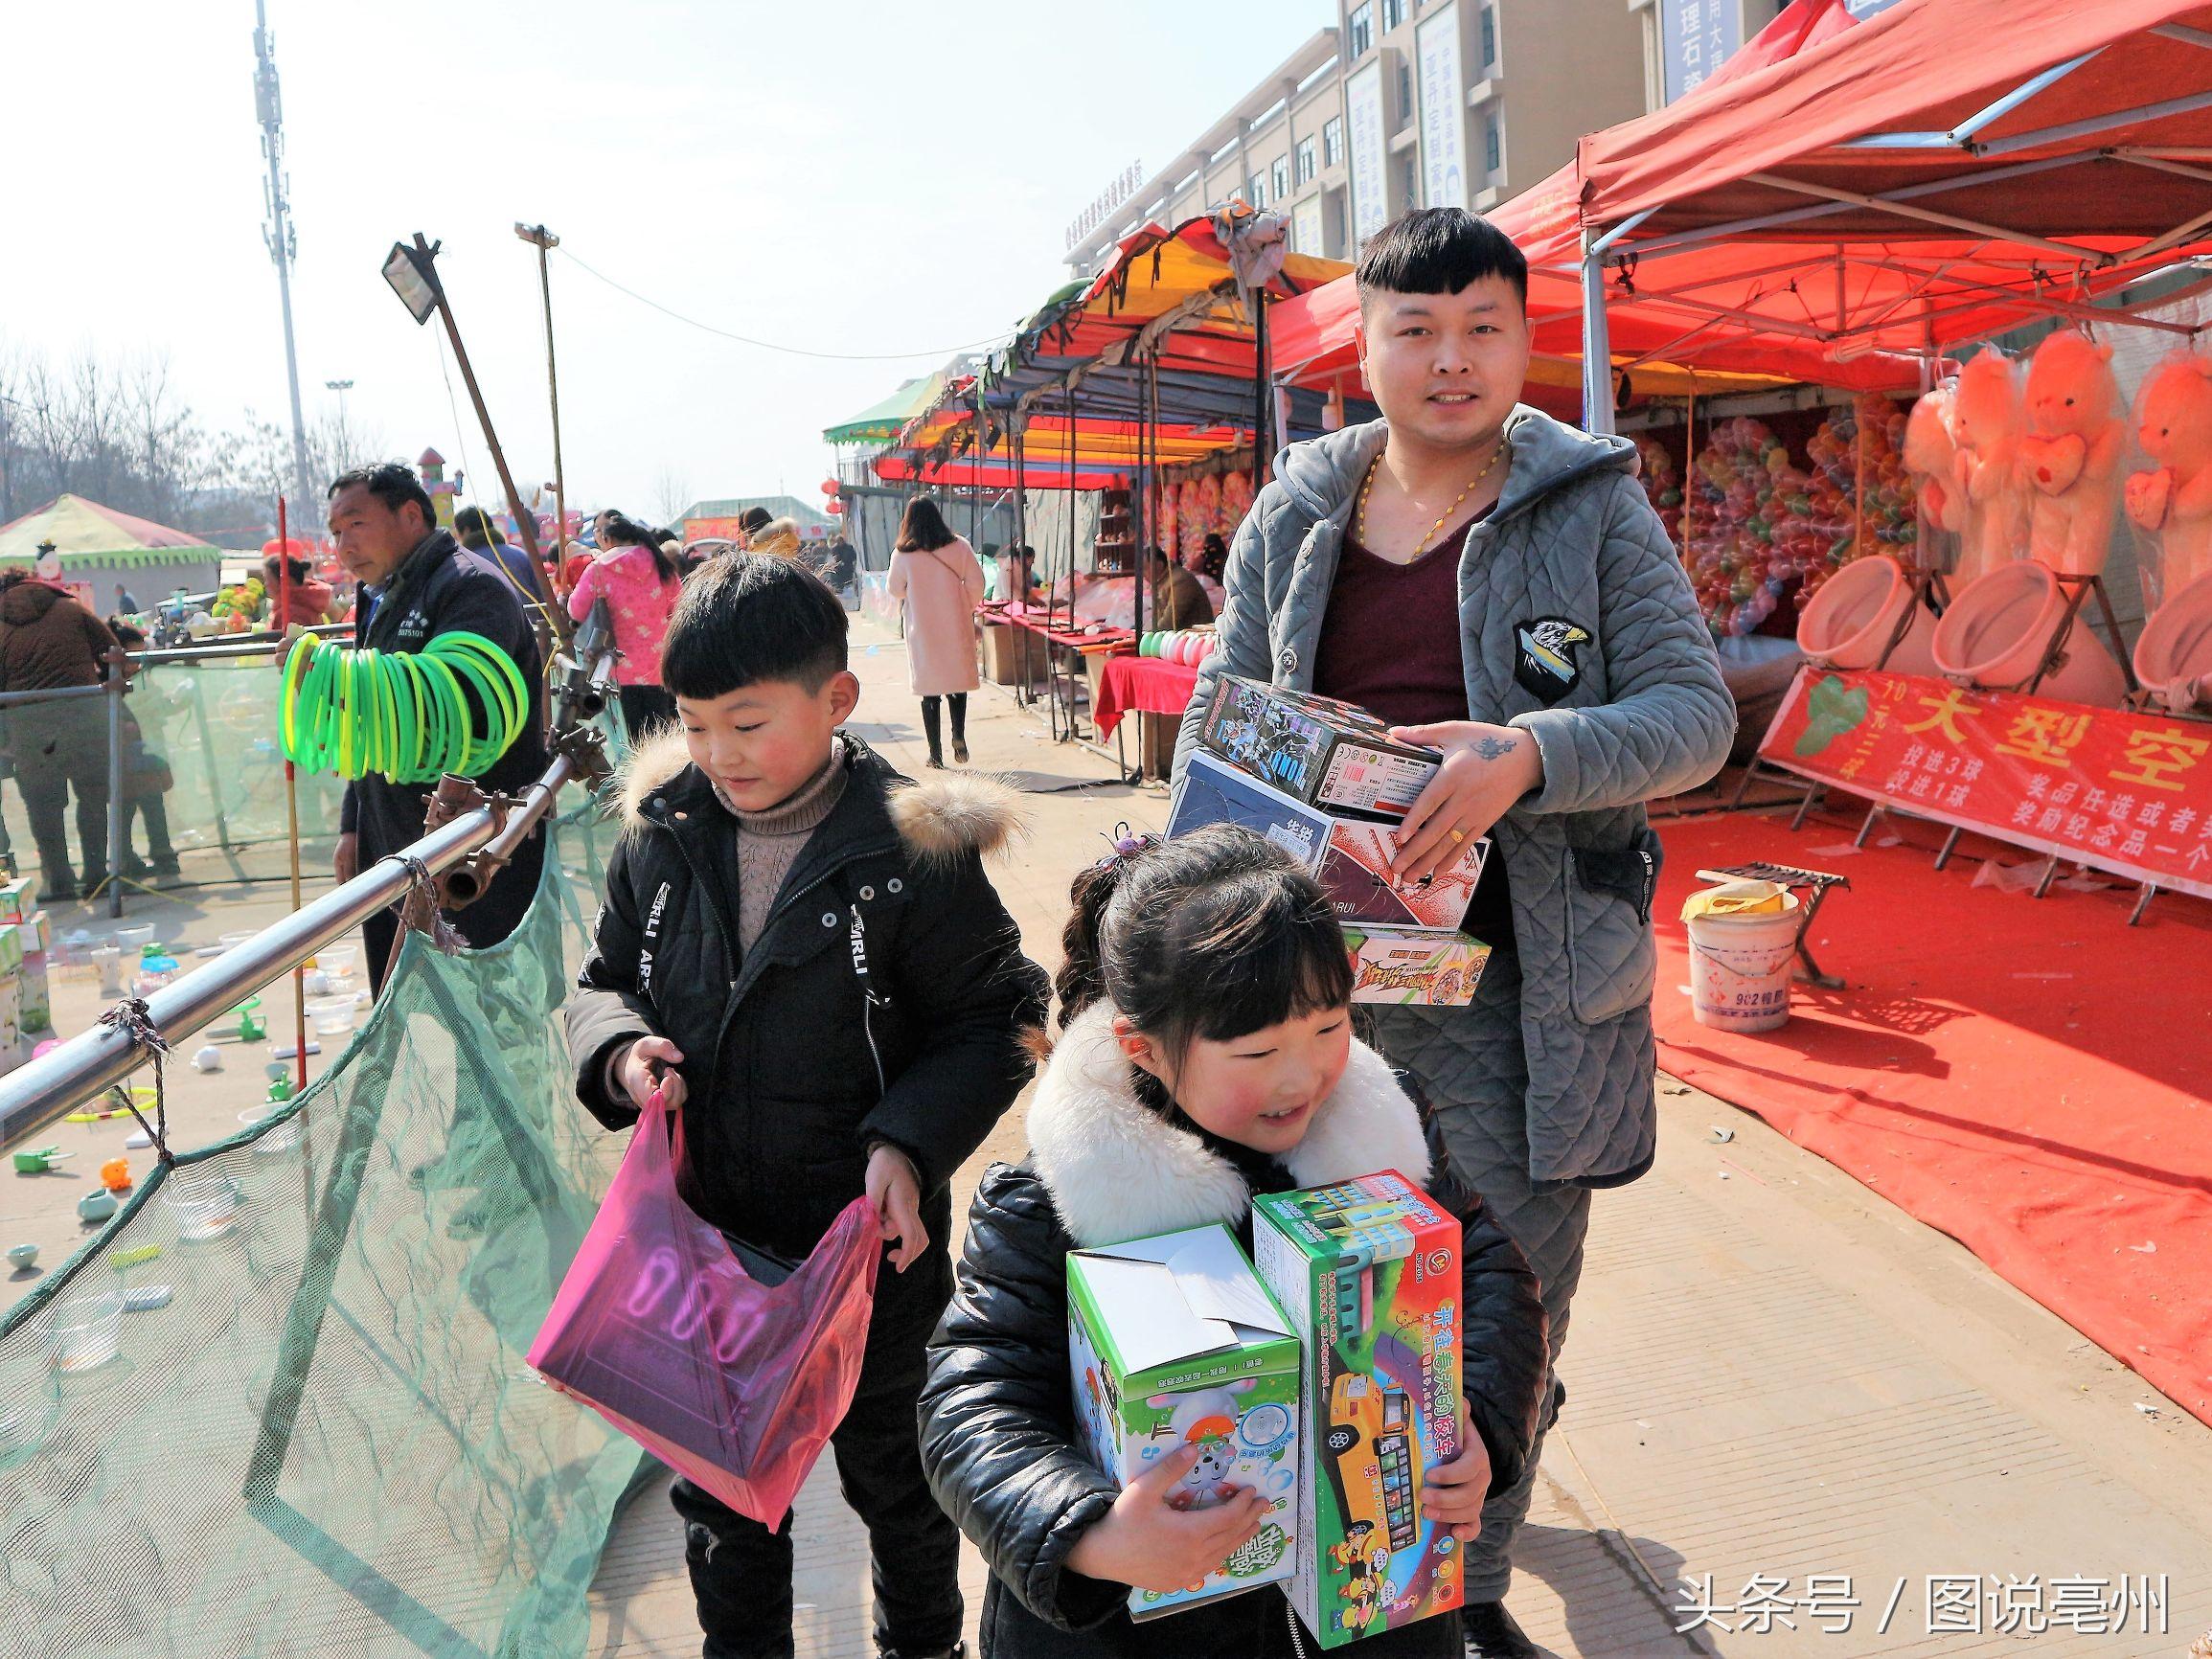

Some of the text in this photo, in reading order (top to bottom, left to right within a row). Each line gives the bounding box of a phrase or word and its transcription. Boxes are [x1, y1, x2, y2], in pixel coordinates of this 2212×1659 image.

[1679, 0, 1702, 92] 理石
[1901, 743, 1984, 783] 投进3球
[1903, 688, 2211, 792] 大型空
[1885, 768, 2210, 872] 投进1球 奖励纪念品一个
[1333, 901, 1356, 914] RUI
[1433, 1307, 1455, 1460] 开往春天的校车
